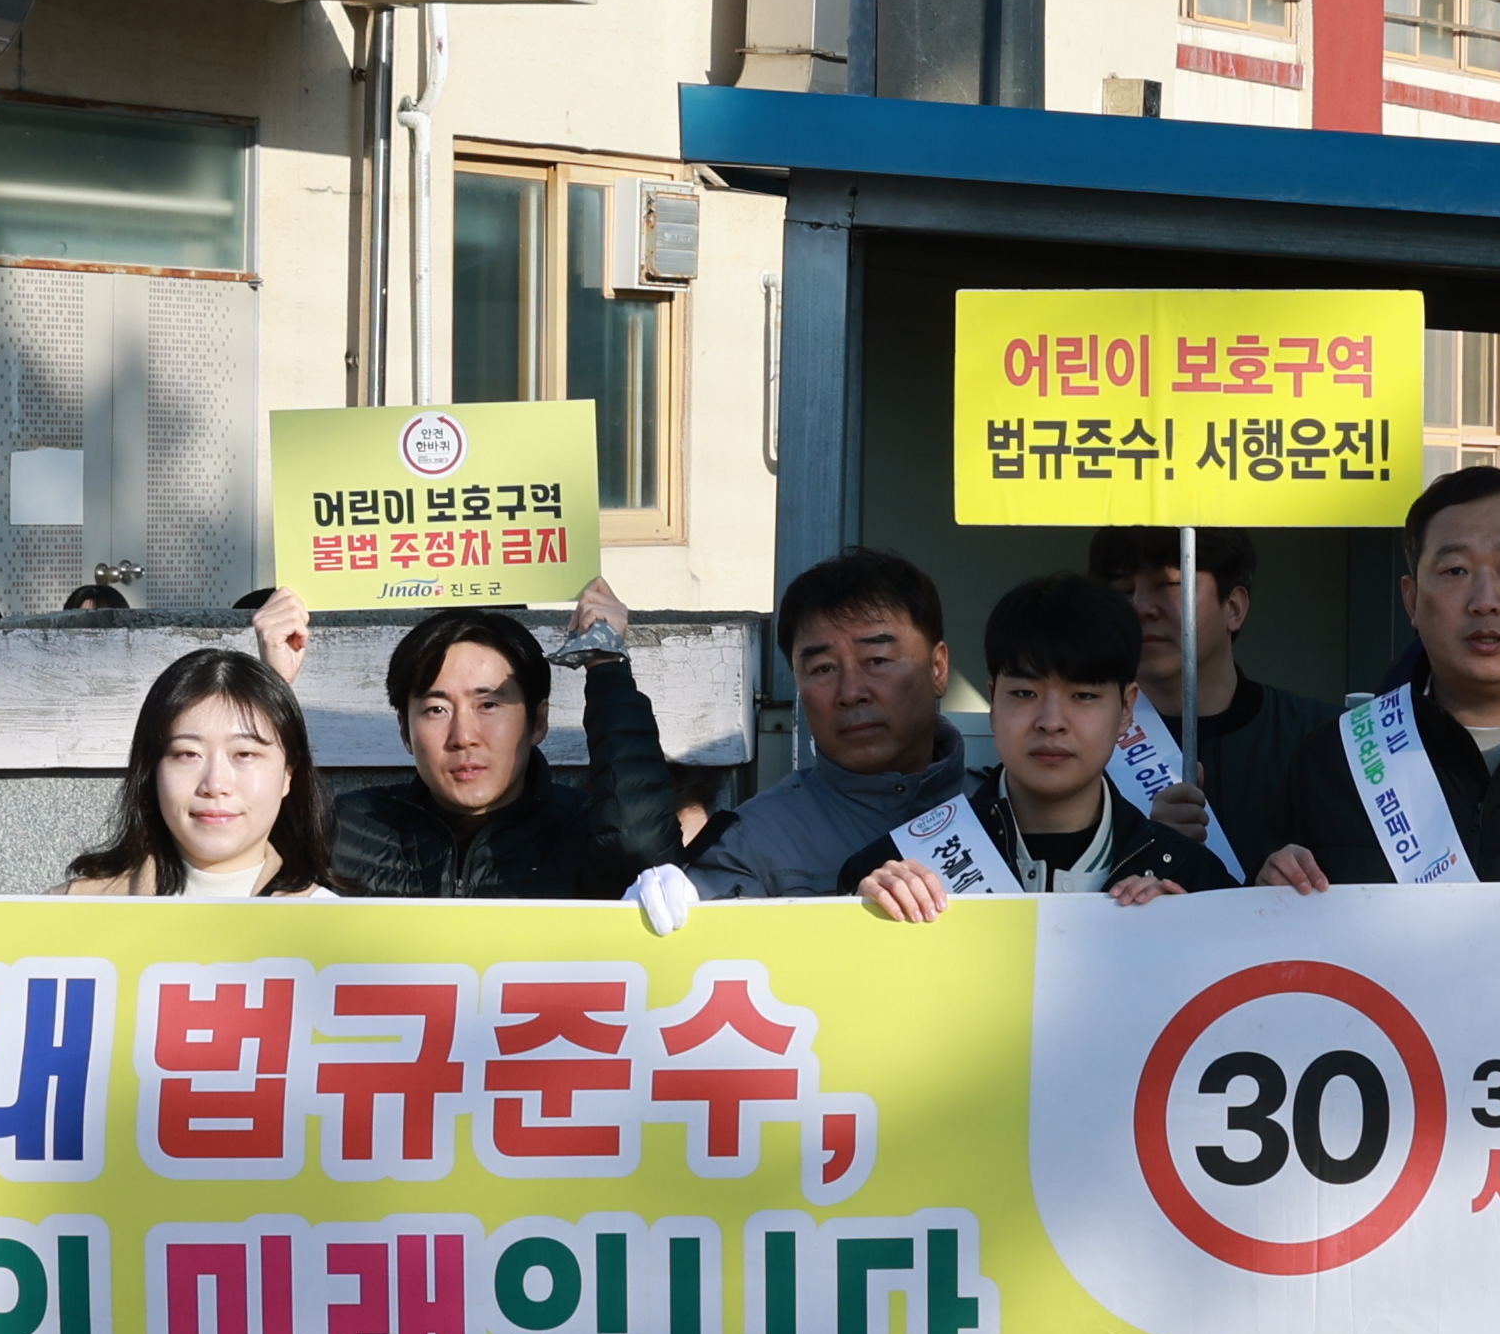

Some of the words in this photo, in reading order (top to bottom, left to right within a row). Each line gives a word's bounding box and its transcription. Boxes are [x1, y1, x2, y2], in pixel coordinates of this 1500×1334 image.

[1004, 334, 1150, 397] 어린이
[1172, 334, 1373, 398] 보호구역
[416, 441, 450, 452] 한바퀴
[421, 428, 444, 439] 안전
[987, 418, 1174, 480] 법규준수!
[1196, 418, 1389, 481] 서행운전!
[313, 488, 415, 527] 어린이
[426, 482, 562, 524] 보호구역
[312, 534, 379, 572] 불법
[390, 530, 492, 570] 주정차
[501, 526, 568, 565] 금지
[377, 582, 433, 599] Jindo
[450, 582, 502, 597] 진도군
[1375, 788, 1421, 863] 캠페인
[153, 975, 858, 1186] 법규준수,
[1194, 1048, 1392, 1187] 30
